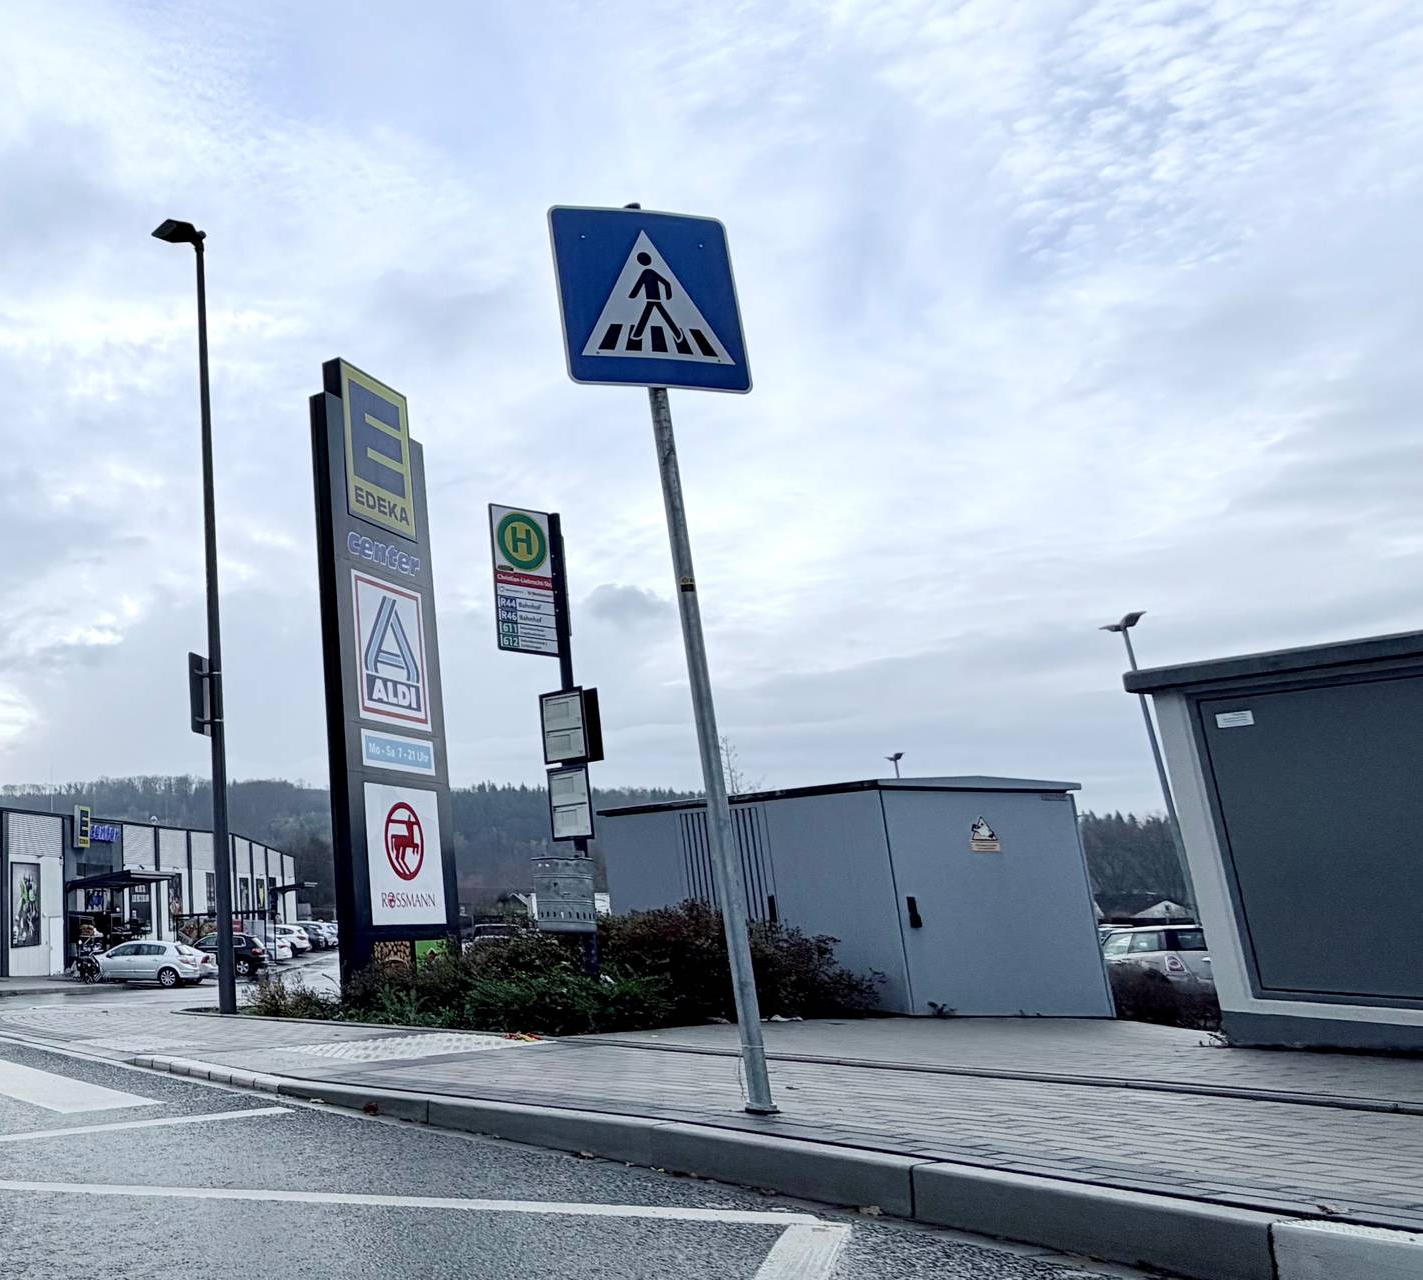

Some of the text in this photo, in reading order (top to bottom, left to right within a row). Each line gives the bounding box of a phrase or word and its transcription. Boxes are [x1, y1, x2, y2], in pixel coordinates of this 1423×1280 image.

[348, 378, 406, 499] E
[354, 485, 409, 526] EDEKA
[511, 526, 533, 555] H
[347, 531, 420, 576] center
[500, 597, 541, 610] R44 Bahnhof
[501, 609, 542, 623] R46 Bahnhof
[503, 623, 518, 633] 611
[503, 636, 519, 647] 612
[372, 678, 418, 709] ALDI
[398, 747, 403, 758] 7
[381, 891, 436, 909] ROSSMANN
